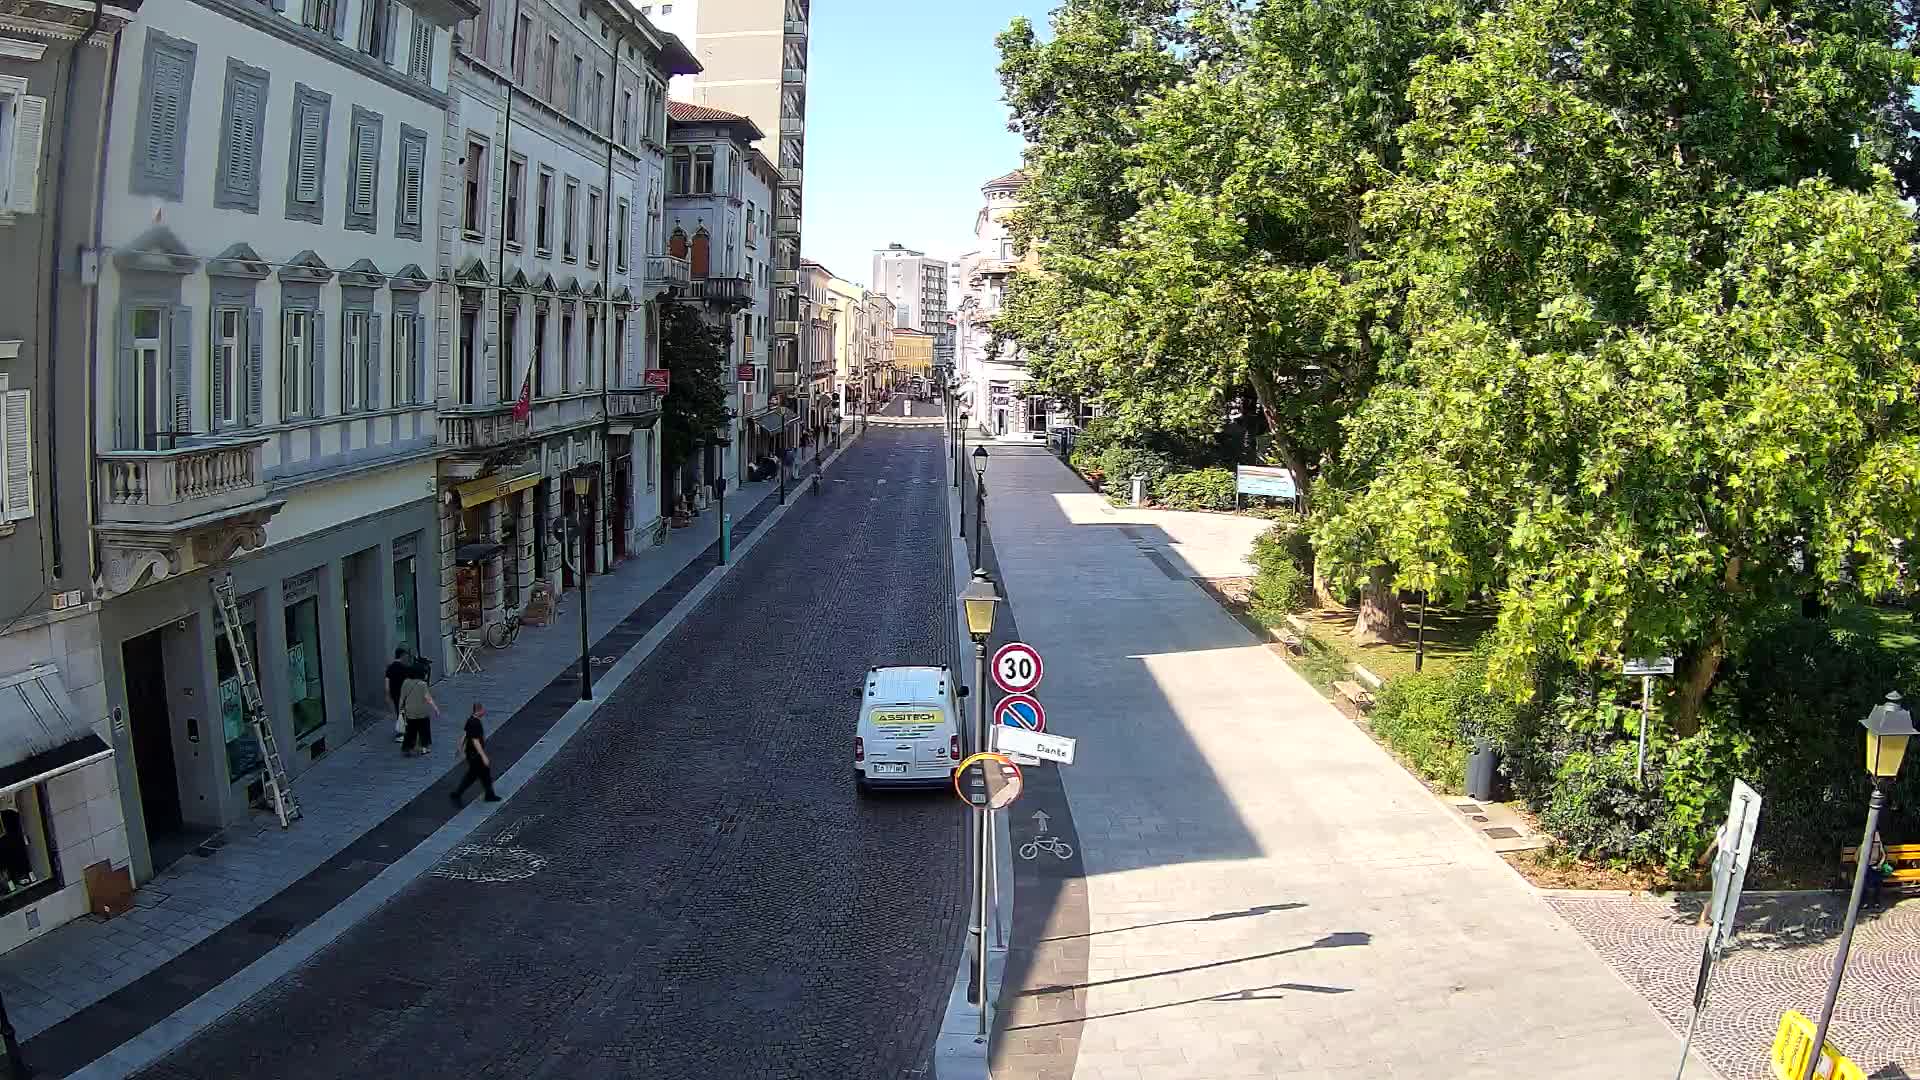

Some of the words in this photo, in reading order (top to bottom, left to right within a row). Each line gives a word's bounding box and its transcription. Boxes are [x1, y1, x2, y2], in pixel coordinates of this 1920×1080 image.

[1005, 658, 1032, 680] 30
[878, 713, 935, 721] ASSITECH
[1036, 743, 1066, 758] Dante
